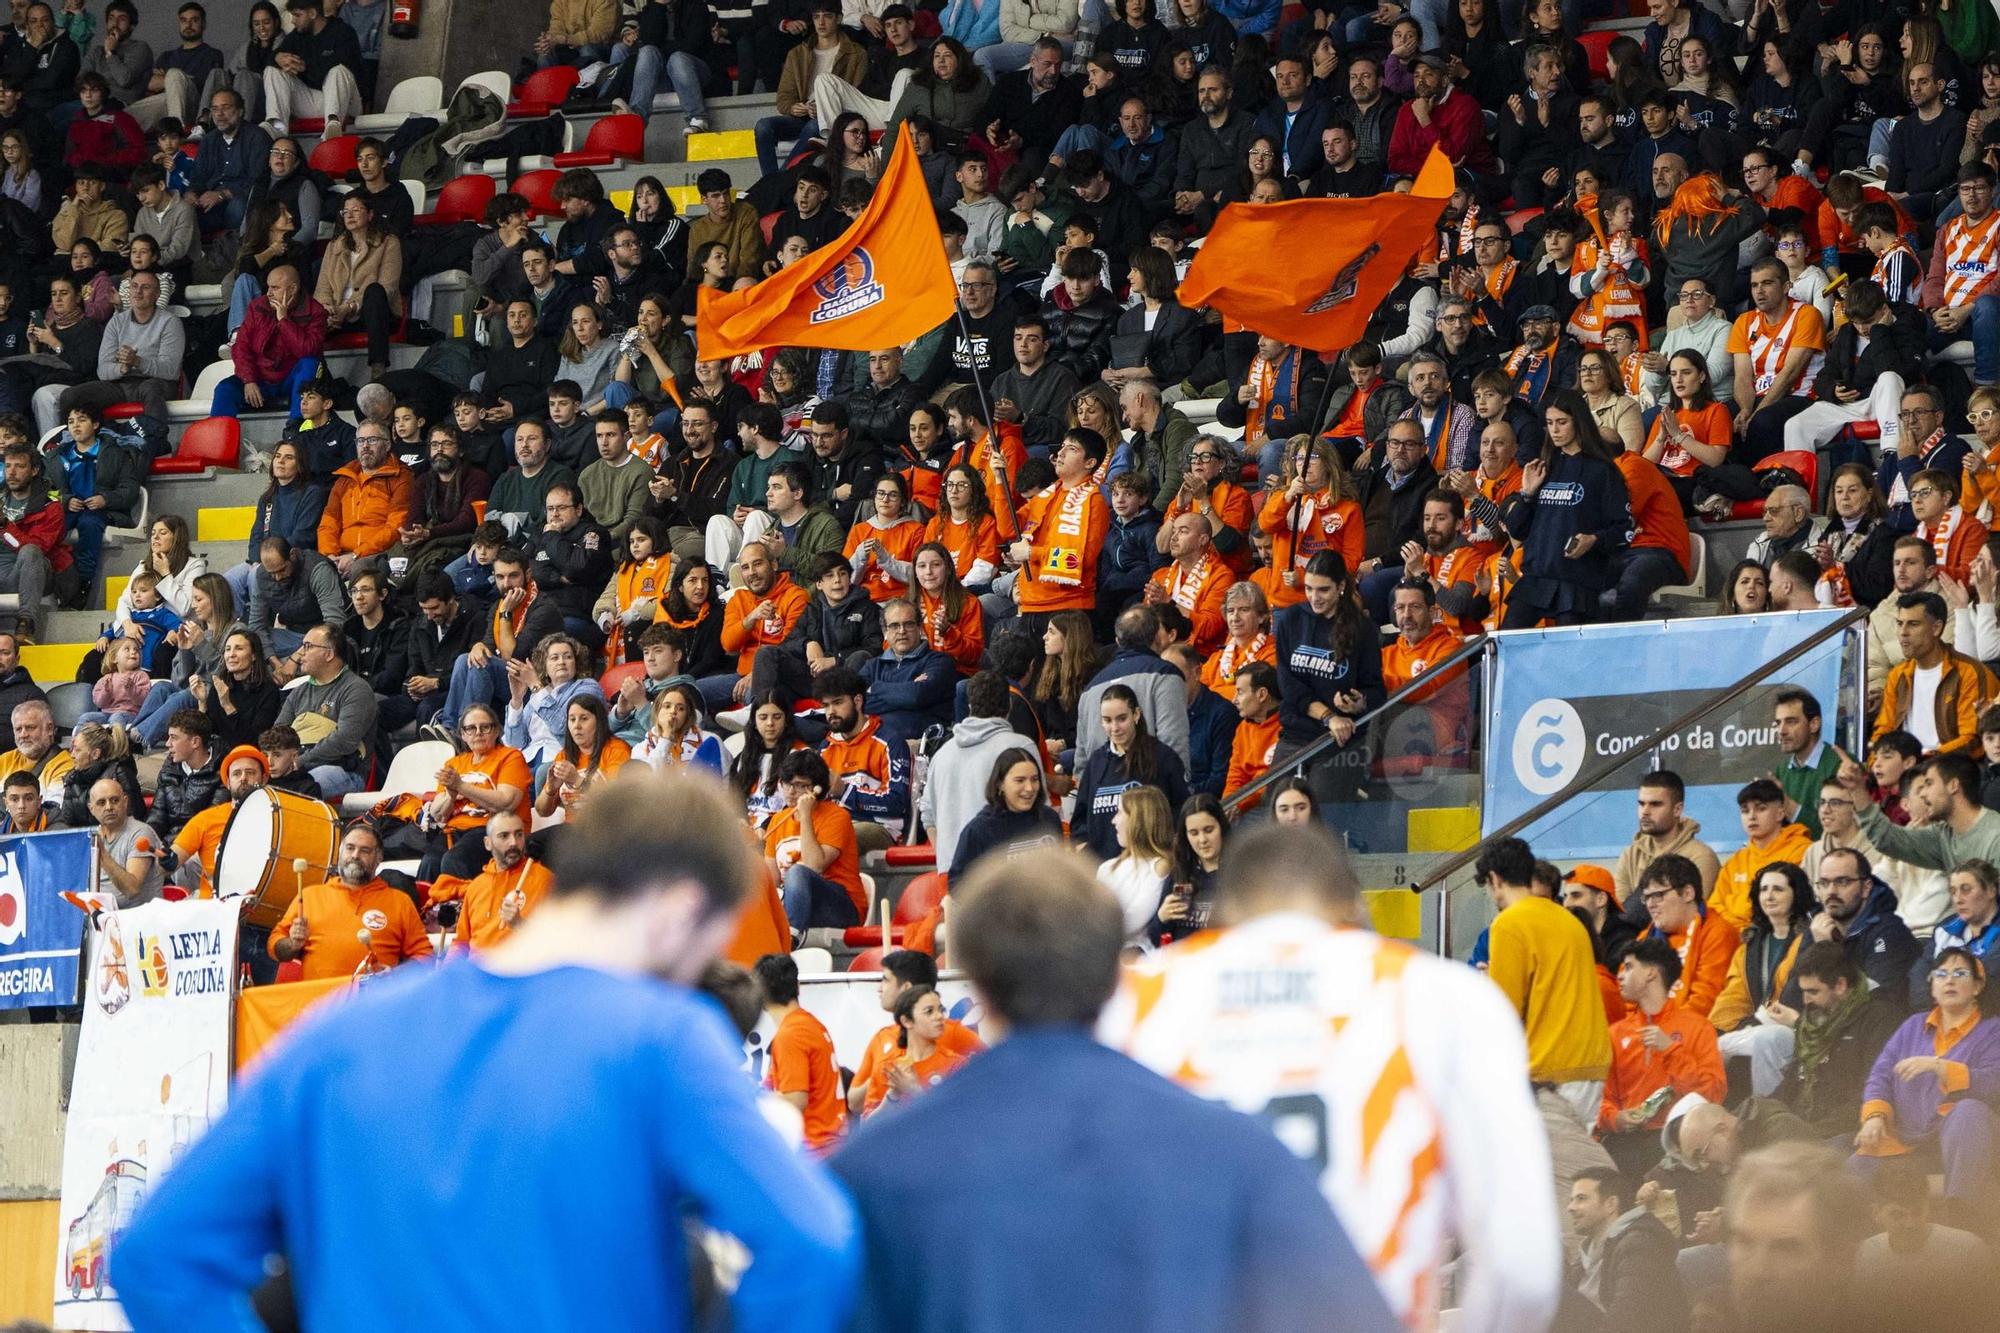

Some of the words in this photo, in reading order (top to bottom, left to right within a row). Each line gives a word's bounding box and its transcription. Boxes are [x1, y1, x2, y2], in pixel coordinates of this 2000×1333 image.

[1290, 653, 1336, 673] ESCLAVAS
[1686, 726, 1714, 749] da
[1394, 865, 1406, 886] 8
[175, 960, 226, 997] CORUÑA
